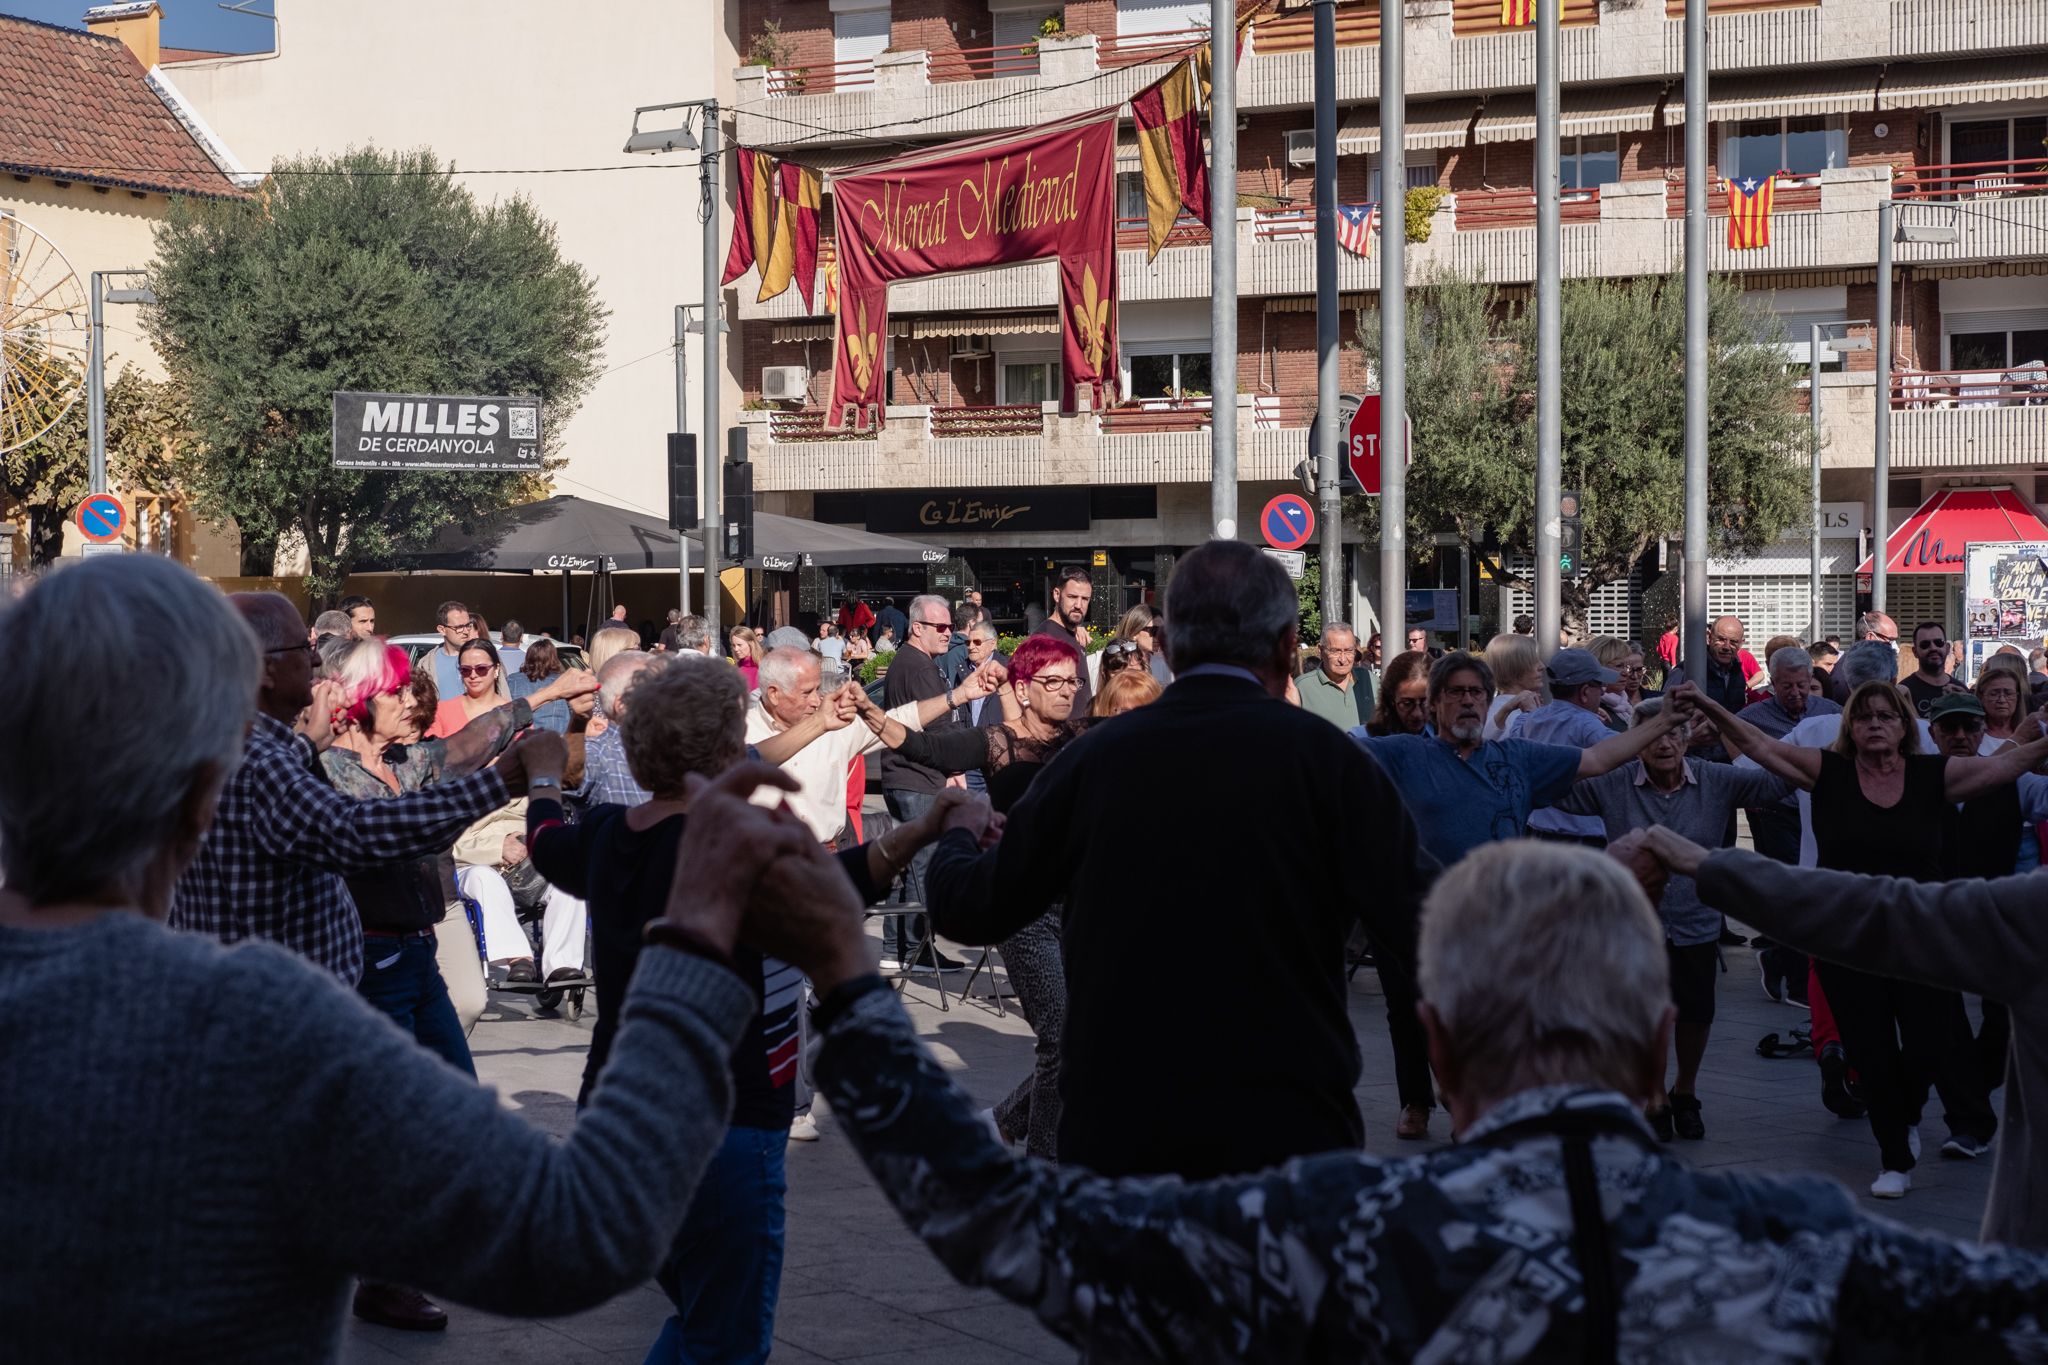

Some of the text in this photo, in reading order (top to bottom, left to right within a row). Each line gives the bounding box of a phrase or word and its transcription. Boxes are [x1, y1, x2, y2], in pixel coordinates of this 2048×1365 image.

[860, 138, 1083, 256] Mercat Medieval
[361, 401, 500, 435] MILLES
[358, 437, 495, 454] DE CERDANYOLA
[1352, 433, 1381, 457] ST
[1823, 512, 1849, 528] LS
[2013, 572, 2029, 589] HA
